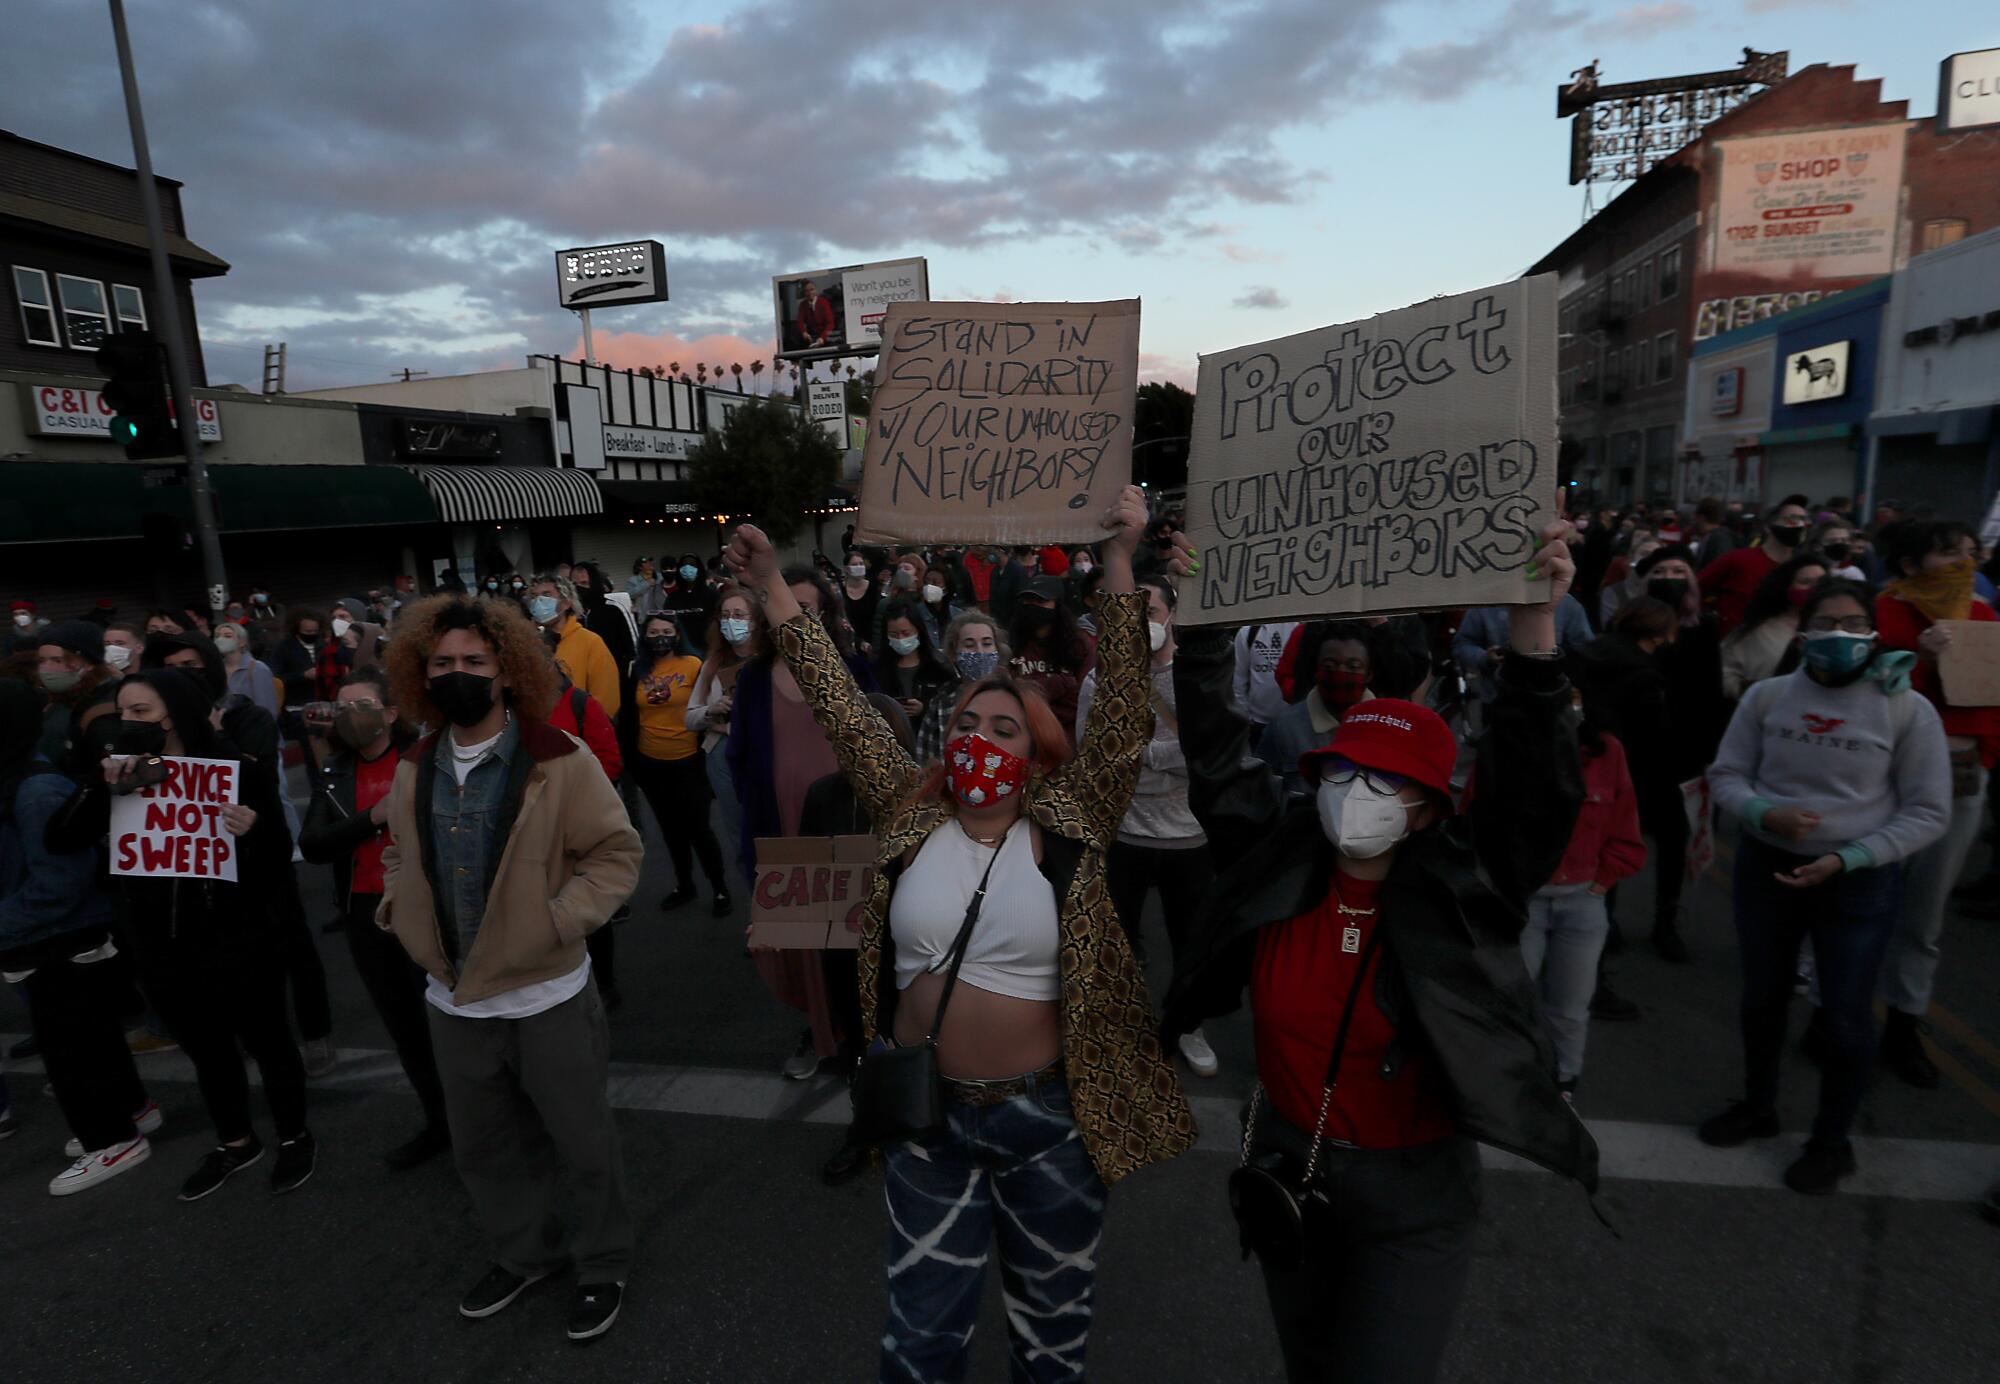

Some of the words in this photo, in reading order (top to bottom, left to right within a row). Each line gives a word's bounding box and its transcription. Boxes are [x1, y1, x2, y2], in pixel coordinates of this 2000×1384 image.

[1780, 158, 1842, 181] SHOP
[1726, 225, 1758, 240] 1702
[1763, 220, 1820, 238] SUNSET
[850, 297, 864, 307] my
[867, 289, 915, 305] neighbor?
[851, 281, 878, 293] Won't
[879, 280, 897, 293] you
[898, 277, 911, 287] be
[1221, 296, 1511, 440] Protect
[40, 387, 89, 415] C&I
[812, 403, 842, 415] RODEO
[45, 415, 110, 430] CASUAL
[914, 402, 1000, 448] OUR
[1006, 407, 1121, 443] UNHOUSED
[606, 433, 646, 452] Breakfast
[654, 436, 675, 454] Lunch
[1297, 411, 1395, 467] OUR
[1779, 727, 1860, 751] MAINE
[142, 759, 234, 803] RVICE
[145, 802, 222, 837] NOT
[117, 832, 230, 876] SWEEP
[756, 866, 852, 910] CARE
